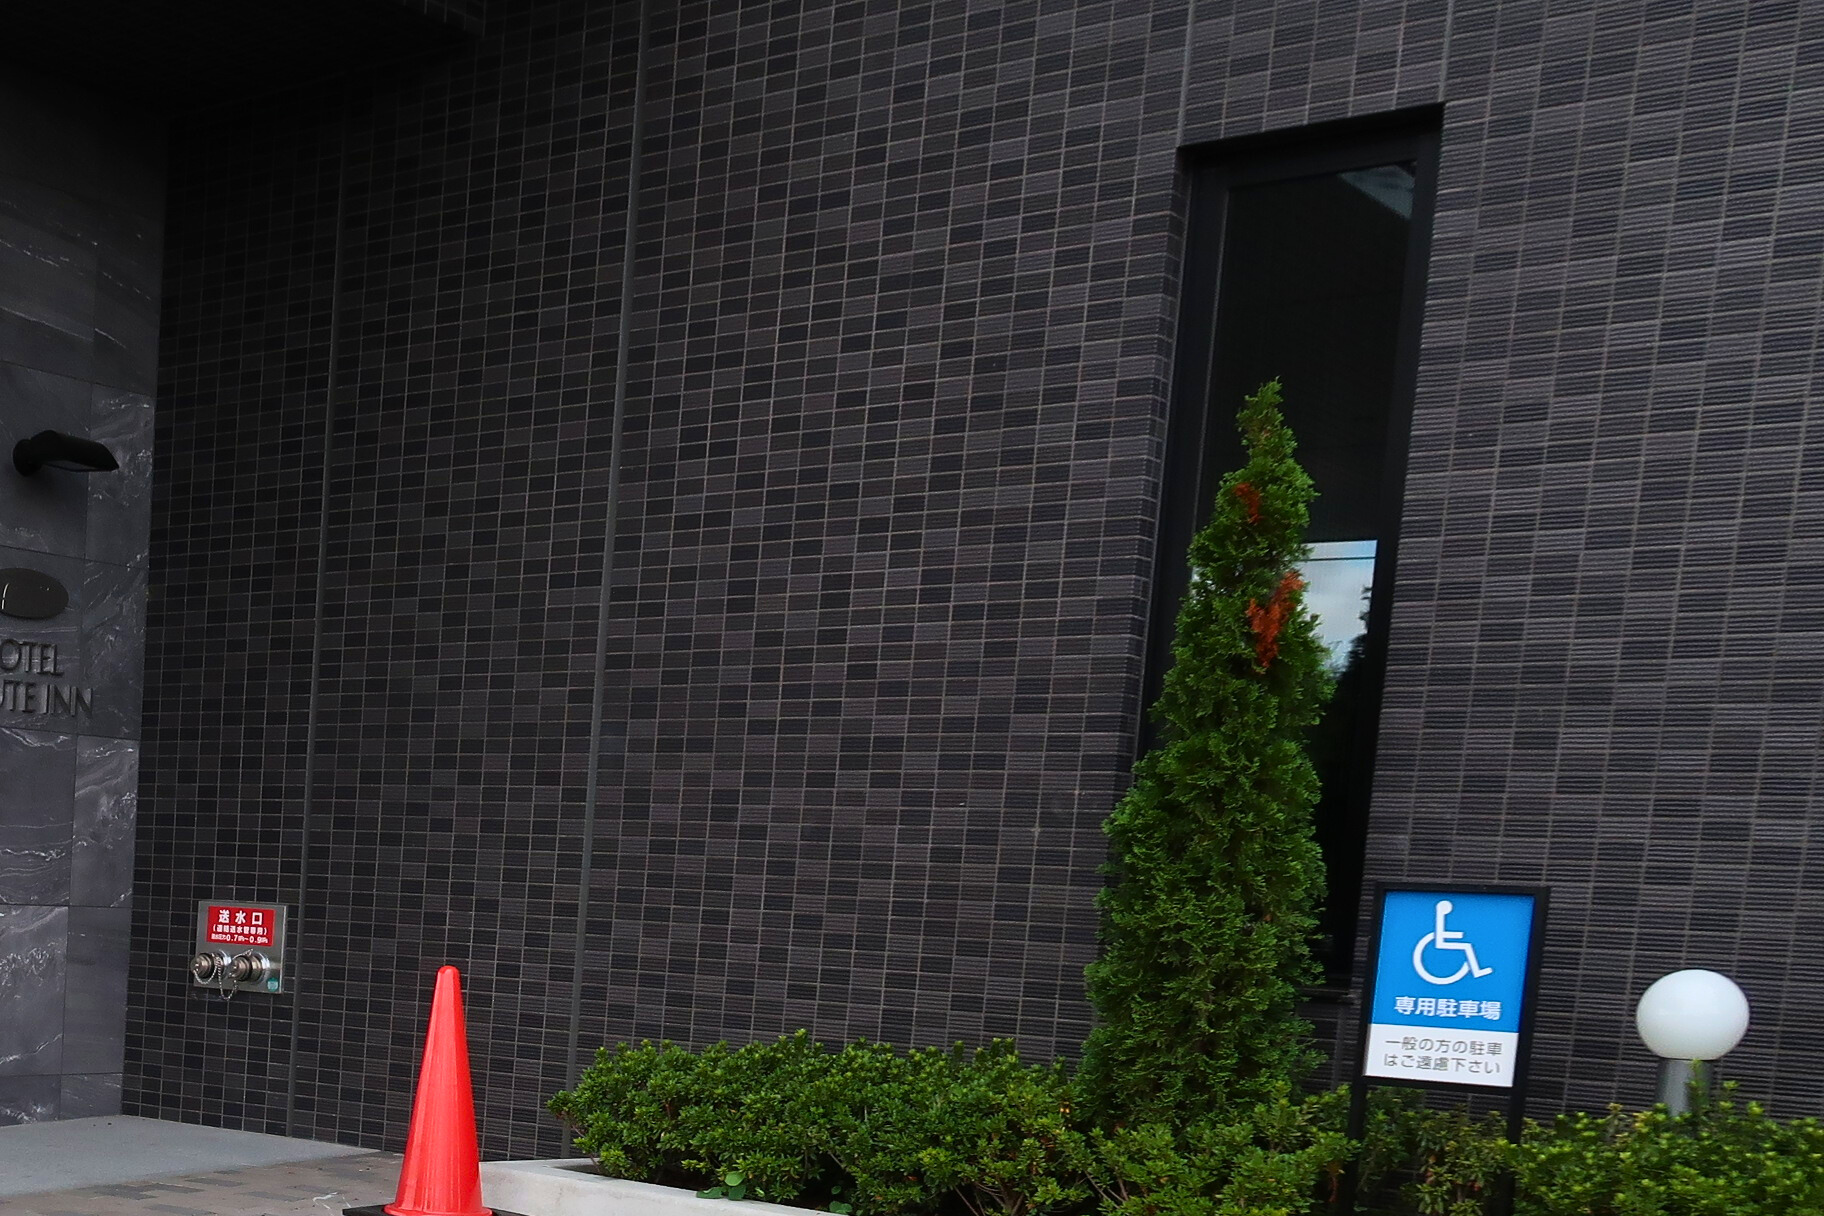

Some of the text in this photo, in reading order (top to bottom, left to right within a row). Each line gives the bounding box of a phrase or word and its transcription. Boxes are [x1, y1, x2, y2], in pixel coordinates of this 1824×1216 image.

[42, 684, 94, 719] INN
[218, 909, 263, 925] 送水口
[1394, 996, 1502, 1021] 専用駐車場
[1384, 1035, 1503, 1056] 一般の方の駐車
[1383, 1053, 1501, 1075] はご遠慮下さい
